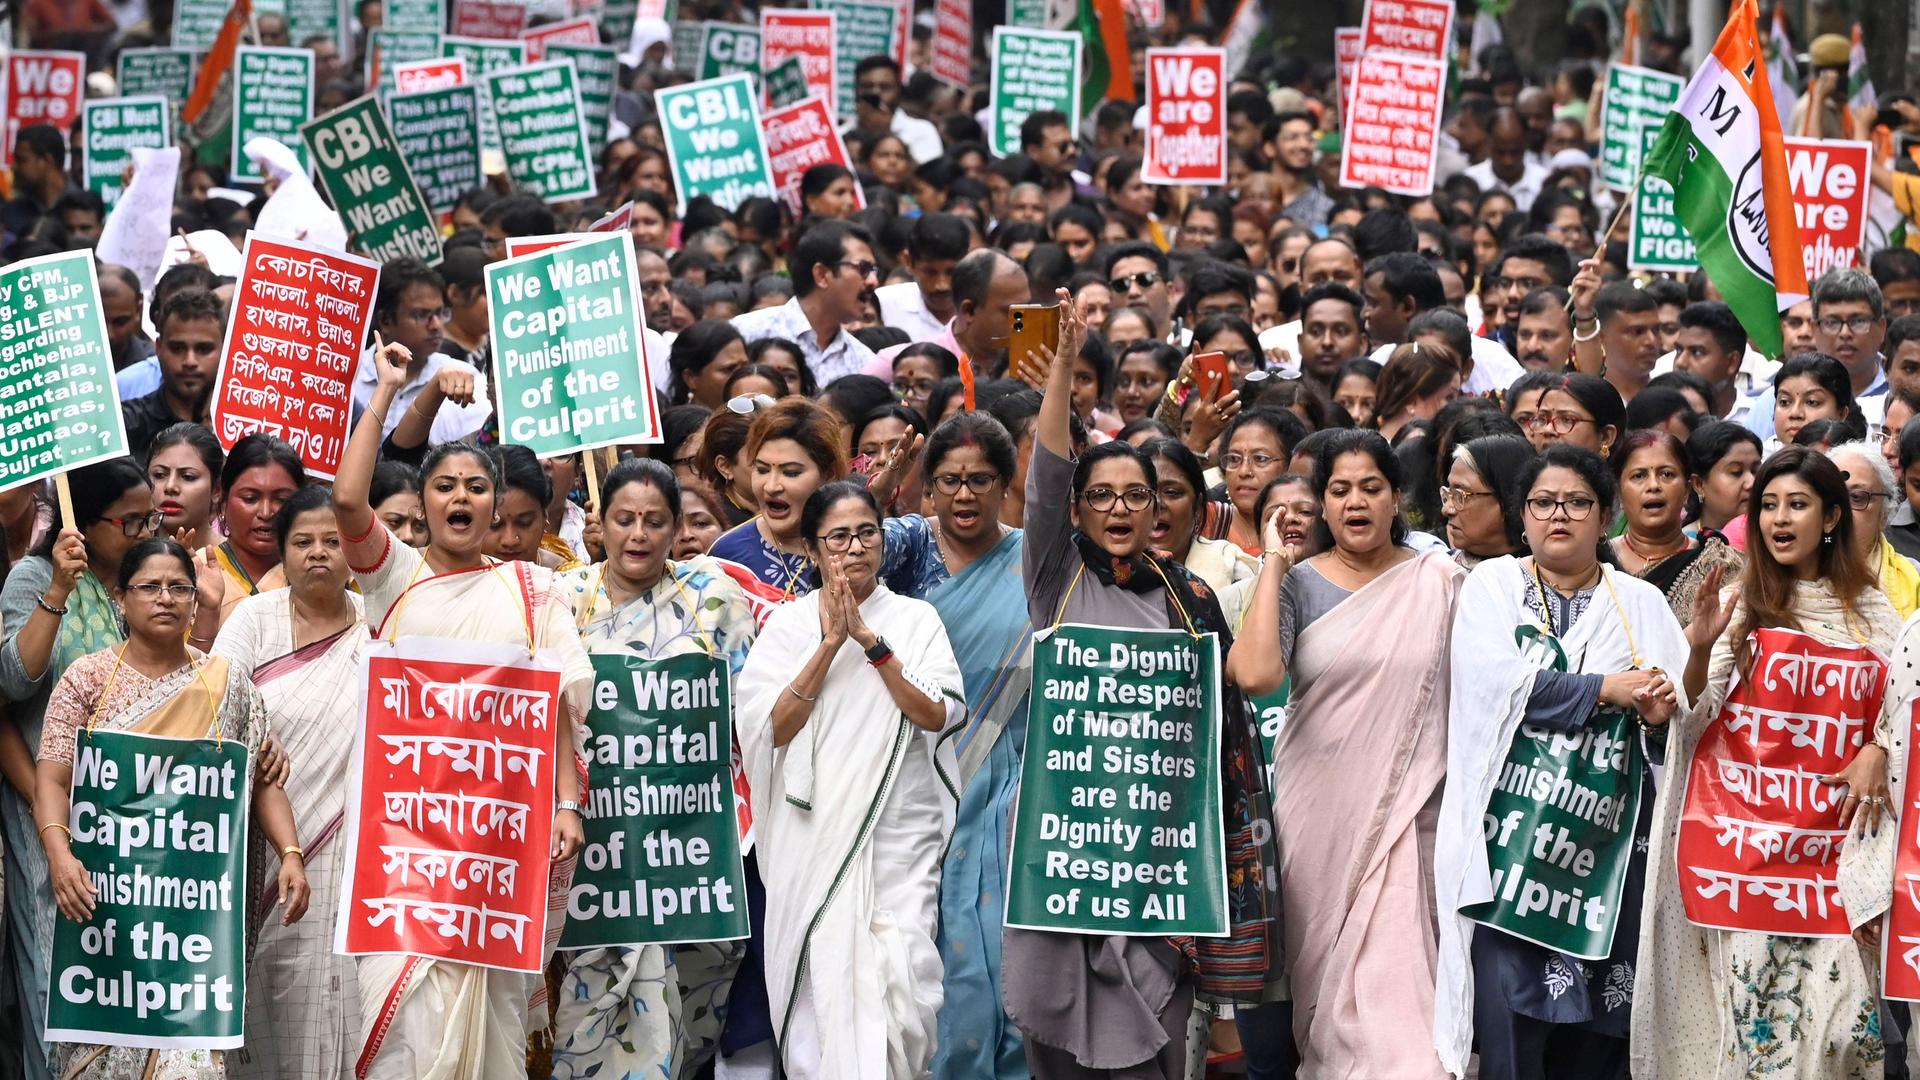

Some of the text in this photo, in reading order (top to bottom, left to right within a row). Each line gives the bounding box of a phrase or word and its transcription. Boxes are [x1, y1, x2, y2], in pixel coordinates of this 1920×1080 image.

[245, 55, 305, 74] The Dignity
[709, 31, 760, 64] CB
[1005, 36, 1071, 57] The Dignity
[14, 58, 75, 96] We
[245, 86, 258, 100] of
[498, 69, 562, 94] We will
[1004, 66, 1019, 80] of
[1154, 57, 1217, 98] We
[16, 96, 69, 119] are
[91, 105, 160, 129] CBI Must
[393, 93, 473, 118] This is a Big
[495, 87, 573, 114] Combat
[667, 85, 749, 130] CBI,
[1158, 100, 1213, 124] are
[90, 129, 163, 153] Complete
[314, 109, 391, 170] CBI,
[501, 119, 522, 137] the
[521, 108, 577, 134] Political
[689, 127, 739, 153] We
[505, 131, 578, 155] Conspiracy
[1152, 124, 1221, 177] Together
[343, 164, 391, 197] We
[559, 169, 587, 188] BJP
[683, 149, 757, 182] Want
[1785, 149, 1857, 199] We
[348, 187, 416, 235] Want
[1640, 216, 1676, 236] We
[1639, 237, 1698, 260] FIGH
[1802, 236, 1855, 281] ether
[18, 268, 68, 292] CPM,
[256, 254, 365, 297] কোচবিহার,
[497, 249, 622, 305] We Want
[24, 284, 84, 310] & BJP
[251, 278, 361, 324] বানতলা, ধানতলা,
[502, 287, 623, 340] Capital
[1, 303, 88, 340] SILENT
[246, 304, 356, 349] হাথরাস, উন্নাও,
[0, 325, 82, 362] garding
[0, 340, 101, 380] ochbehar,
[243, 333, 351, 374] গুজরাত নিয়ে
[505, 325, 629, 378] Punishment
[0, 362, 96, 399] antala,
[232, 352, 347, 402] সিপিএম, কংগ্রেস,
[521, 369, 620, 409] of the
[0, 380, 102, 420] hantala,
[227, 378, 281, 411] বিজেপি
[284, 395, 305, 420] চুপ
[308, 403, 334, 425] কেন
[511, 394, 637, 442] Culprit
[0, 421, 97, 457] Unnao,
[287, 425, 324, 459] দাও
[1054, 638, 1199, 679] The Dignity
[379, 672, 551, 731] মা বোনেদের
[591, 668, 719, 711] e Want
[1044, 676, 1202, 711] and Respect
[1053, 709, 1193, 743] of Mothers
[74, 746, 236, 800] We Want
[377, 734, 547, 787] সম্মান
[1046, 745, 1196, 779] and Sisters
[586, 772, 722, 820] unishment
[1071, 784, 1172, 811] are the
[1493, 757, 1625, 833] unishment
[1716, 759, 1850, 814] আমাদে
[71, 801, 230, 857] Capital
[383, 785, 531, 843] আমাদের
[1040, 813, 1197, 852] Dignity and
[584, 829, 710, 871] of the
[1484, 810, 1595, 878] of the
[88, 863, 232, 911] unishment
[379, 845, 520, 900] সকলের
[1045, 851, 1188, 889] Respect
[567, 876, 735, 925] Culprit
[1045, 889, 1186, 920] of us All
[81, 918, 213, 962] of the
[361, 898, 533, 954] সম্মান
[58, 965, 233, 1019] Culprit
